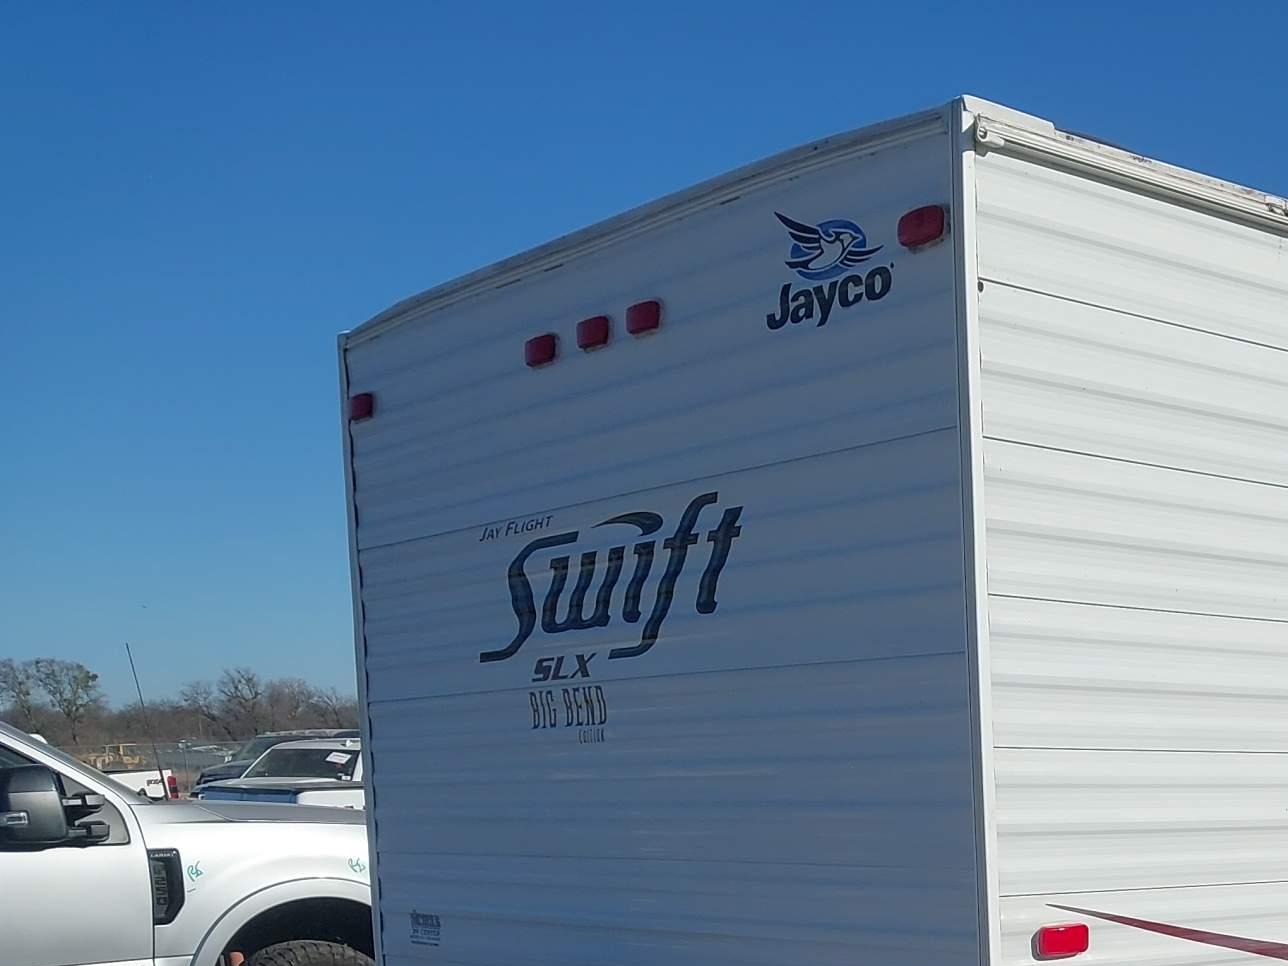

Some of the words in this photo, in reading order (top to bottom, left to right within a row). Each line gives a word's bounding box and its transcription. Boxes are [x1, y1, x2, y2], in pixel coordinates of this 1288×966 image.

[766, 265, 892, 330] Jayco
[479, 527, 502, 542] JAY
[505, 515, 554, 537] FLIGHT
[479, 491, 744, 663] Swift
[532, 653, 597, 682] SLX
[529, 690, 557, 729] BIG
[561, 686, 607, 727] BEND
